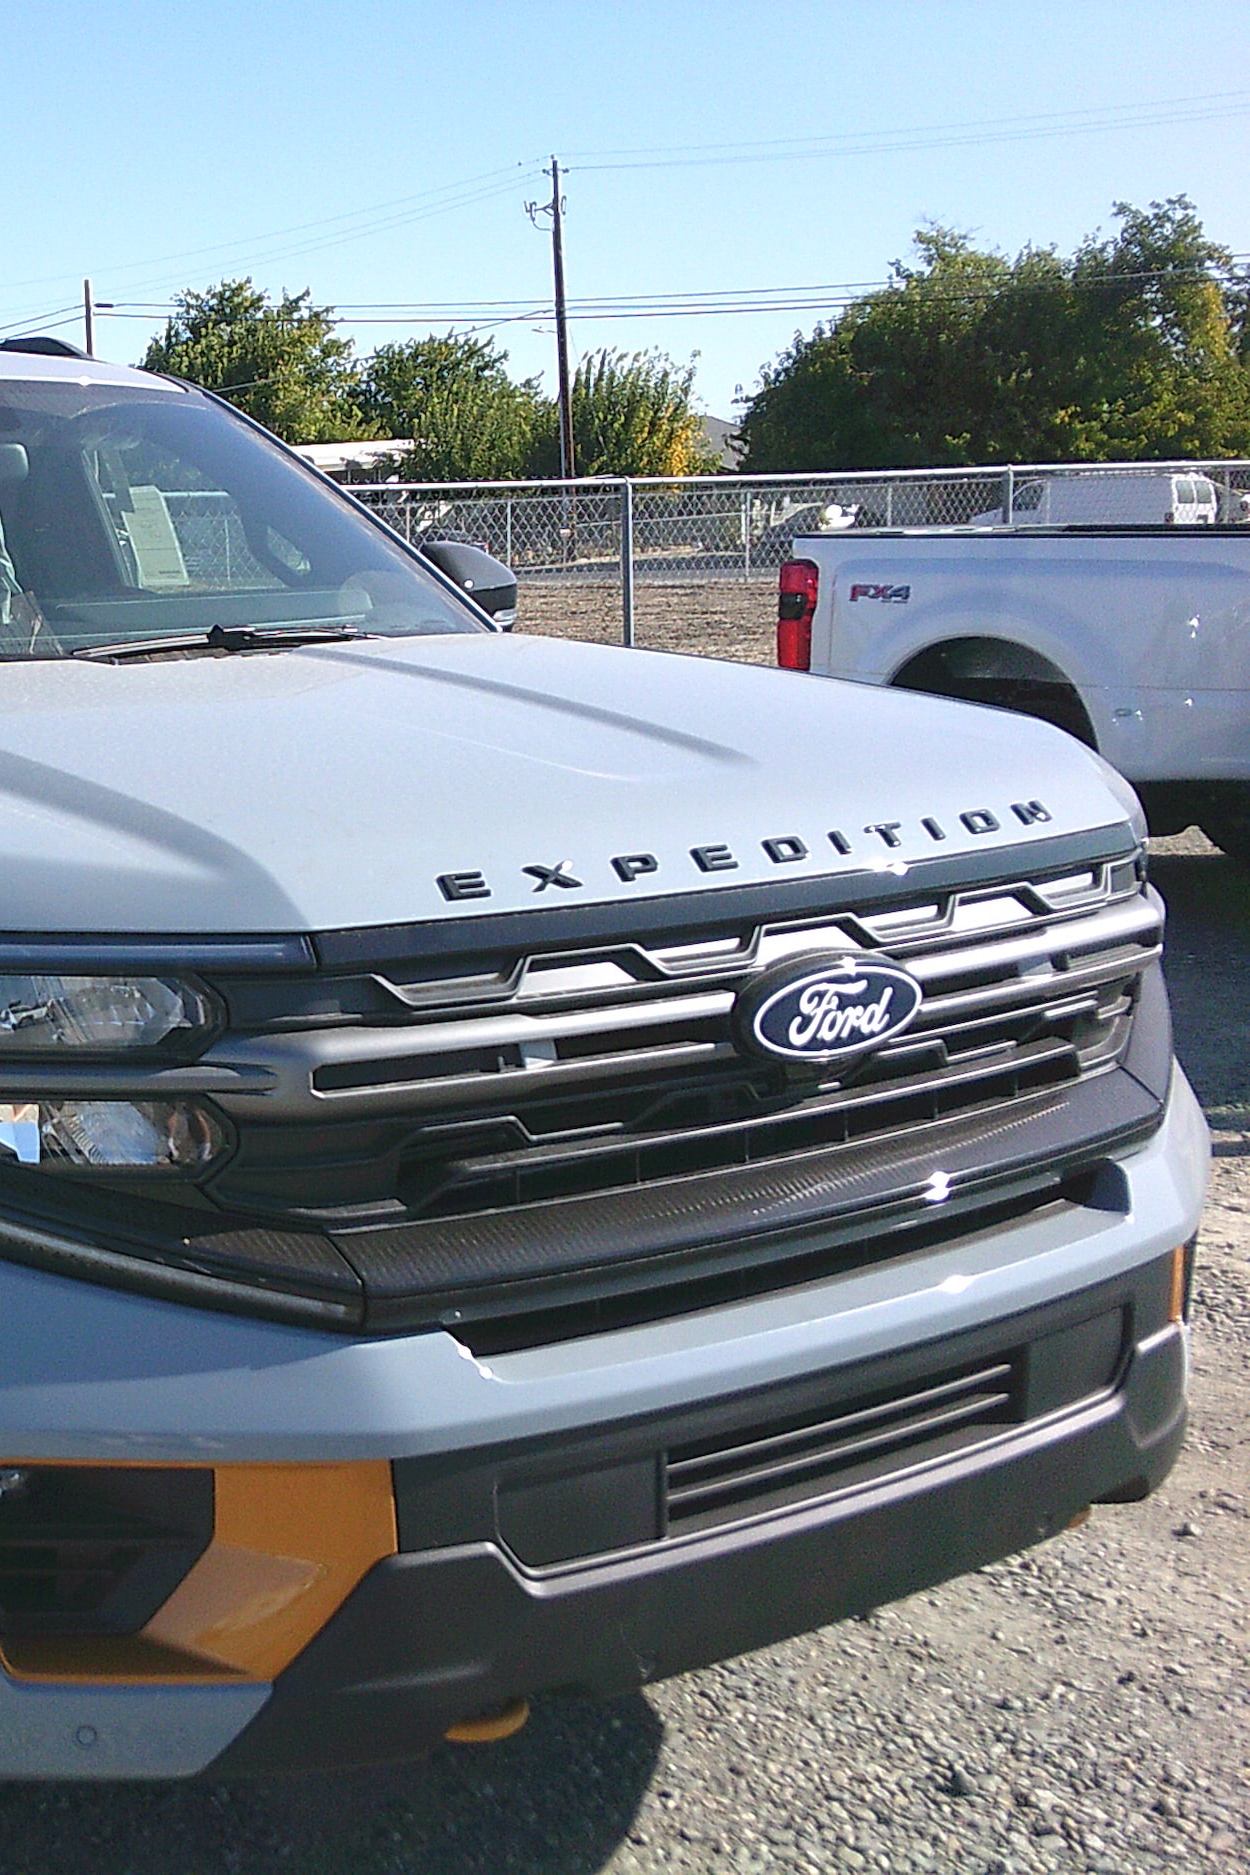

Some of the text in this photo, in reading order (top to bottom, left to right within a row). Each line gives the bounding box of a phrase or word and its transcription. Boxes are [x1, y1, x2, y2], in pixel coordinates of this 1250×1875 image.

[849, 584, 911, 602] FX4
[435, 799, 1053, 902] EXPEDITION
[788, 980, 890, 1046] Ford
